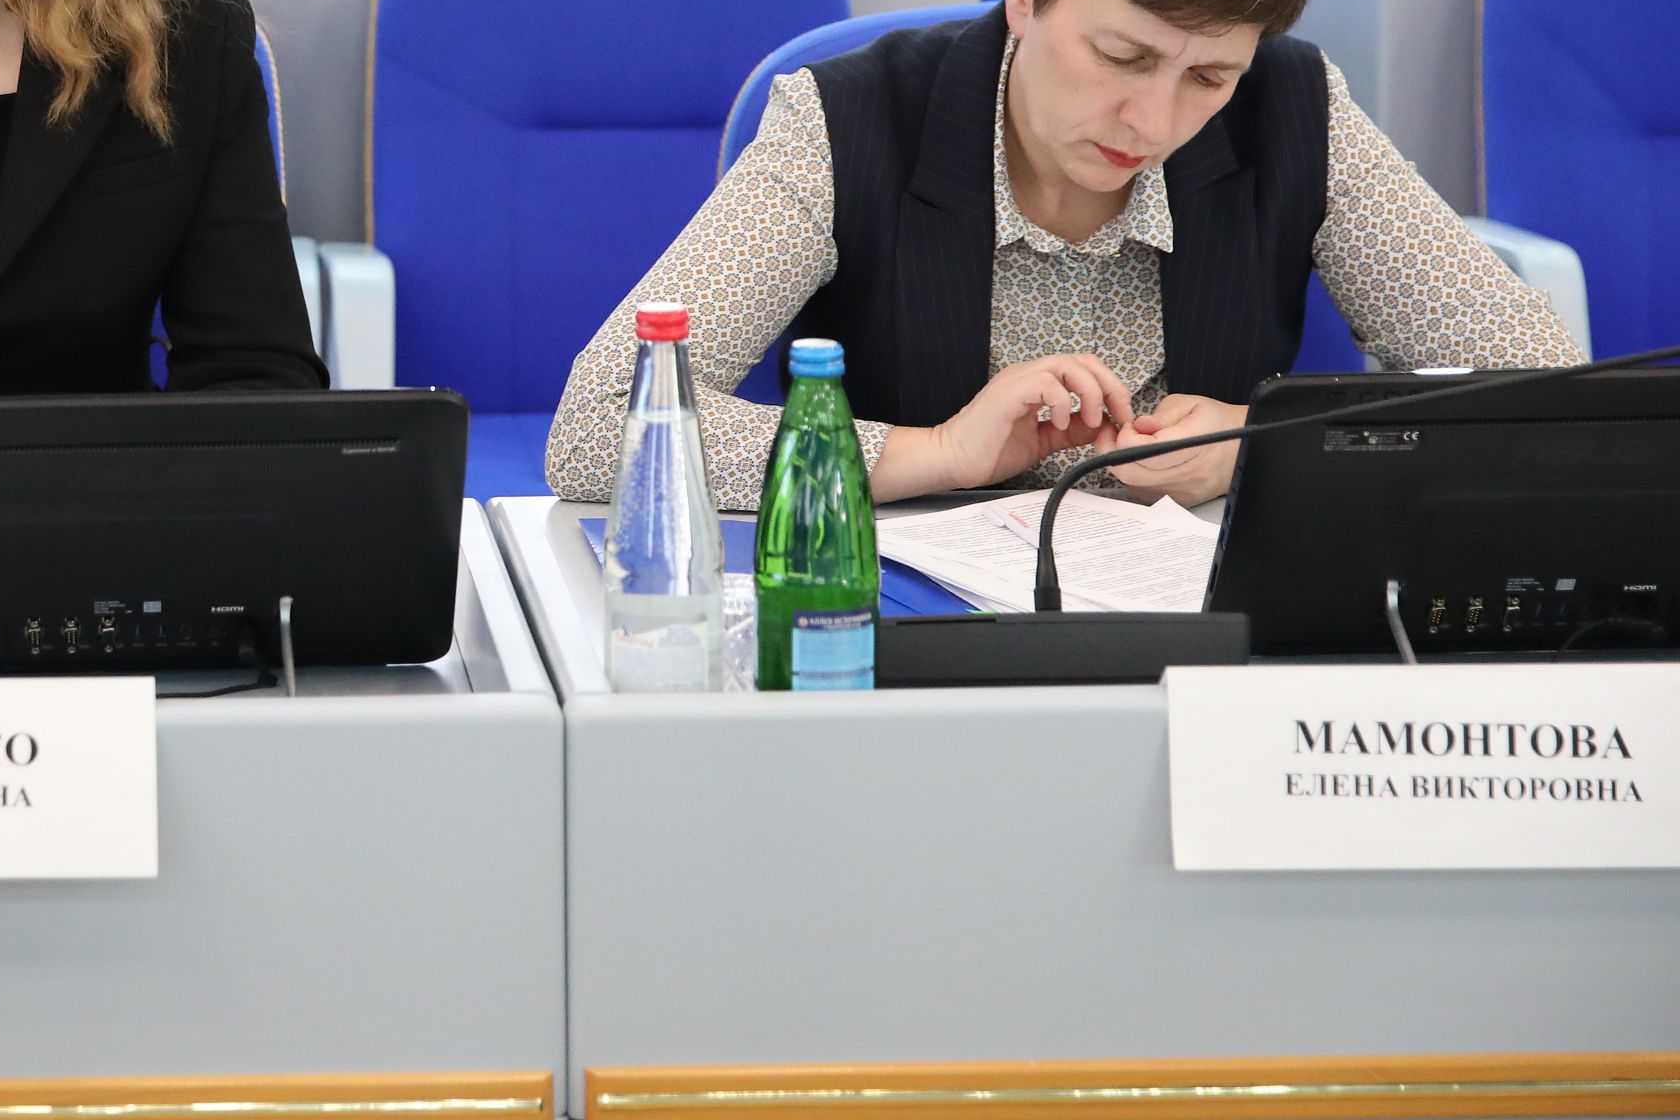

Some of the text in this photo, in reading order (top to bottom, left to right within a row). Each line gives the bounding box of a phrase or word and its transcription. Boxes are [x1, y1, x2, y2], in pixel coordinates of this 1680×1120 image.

[1623, 584, 1657, 592] HDMI
[210, 605, 245, 613] HDMI
[1294, 719, 1634, 760] МАМОНТОВА
[1285, 773, 1644, 802] ЕЛЕНА ВИКТОРОВНА
